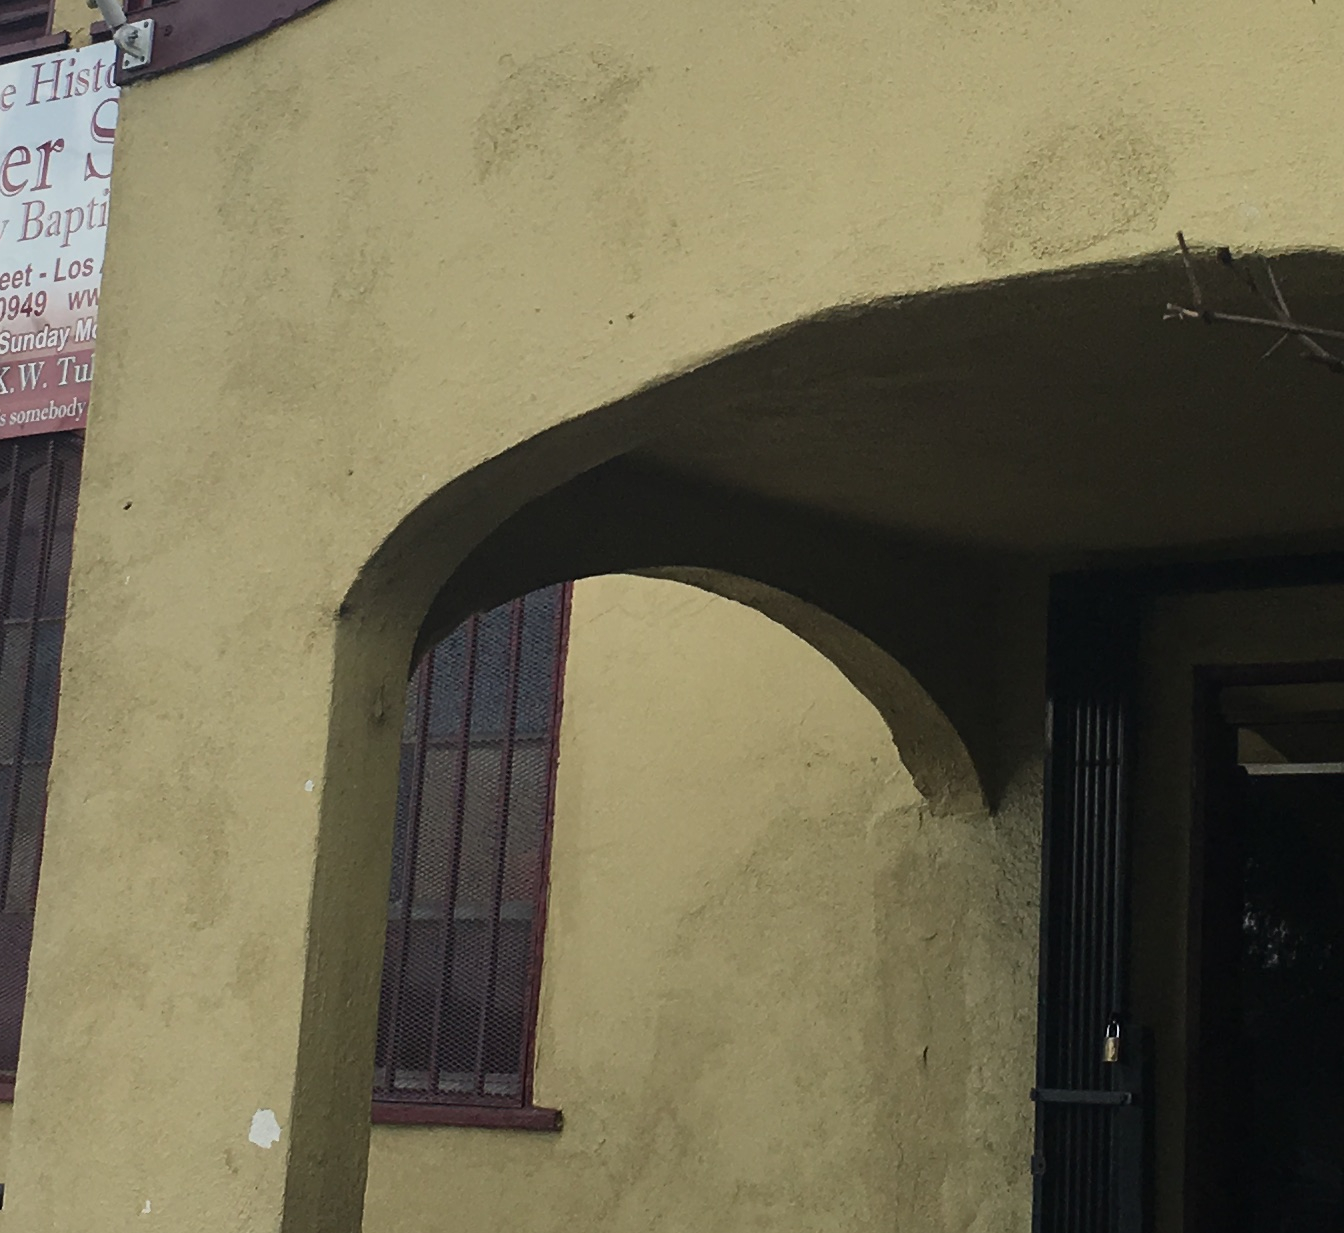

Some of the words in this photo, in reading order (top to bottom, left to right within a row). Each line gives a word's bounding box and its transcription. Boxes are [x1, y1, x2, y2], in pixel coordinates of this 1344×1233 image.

[16, 188, 110, 248] Bapti
[53, 257, 94, 282] Los
[9, 396, 87, 426] somebody
